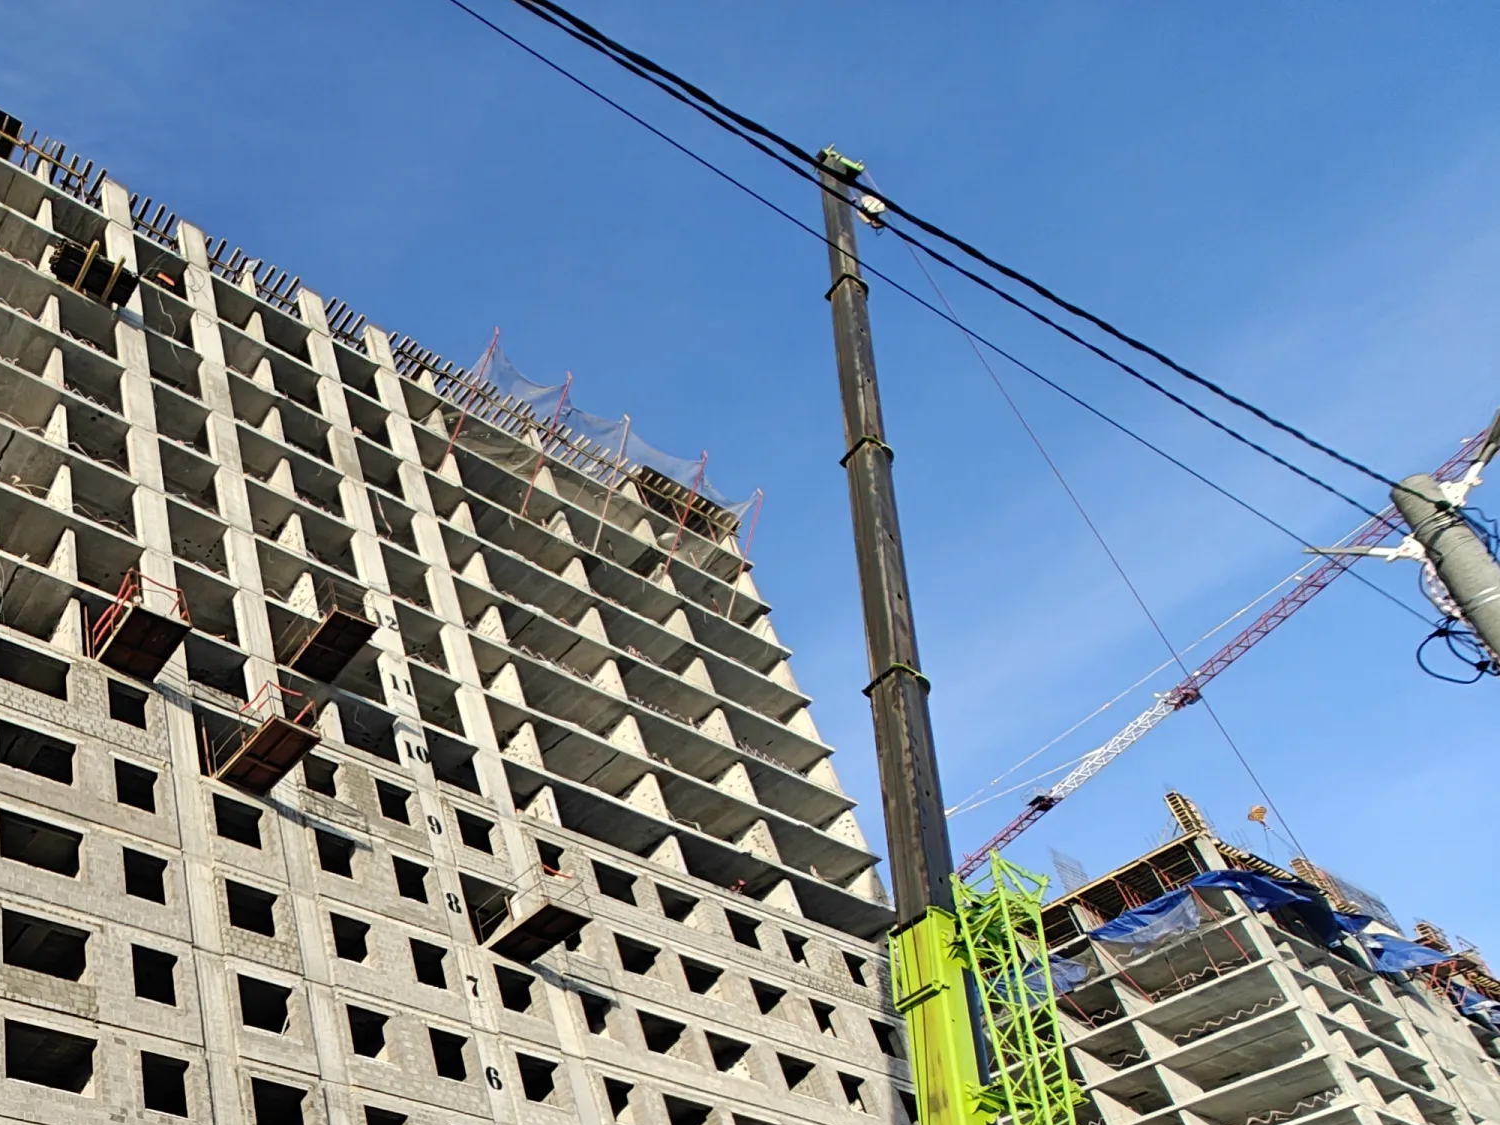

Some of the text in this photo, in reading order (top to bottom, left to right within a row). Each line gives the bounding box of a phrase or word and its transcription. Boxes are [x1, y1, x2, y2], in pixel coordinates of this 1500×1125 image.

[375, 610, 400, 632] 12
[389, 673, 414, 697] 11
[404, 740, 431, 764] 10
[426, 815, 443, 835] 9
[446, 892, 462, 914] 8
[466, 973, 480, 997] 7
[485, 1066, 502, 1090] 6
